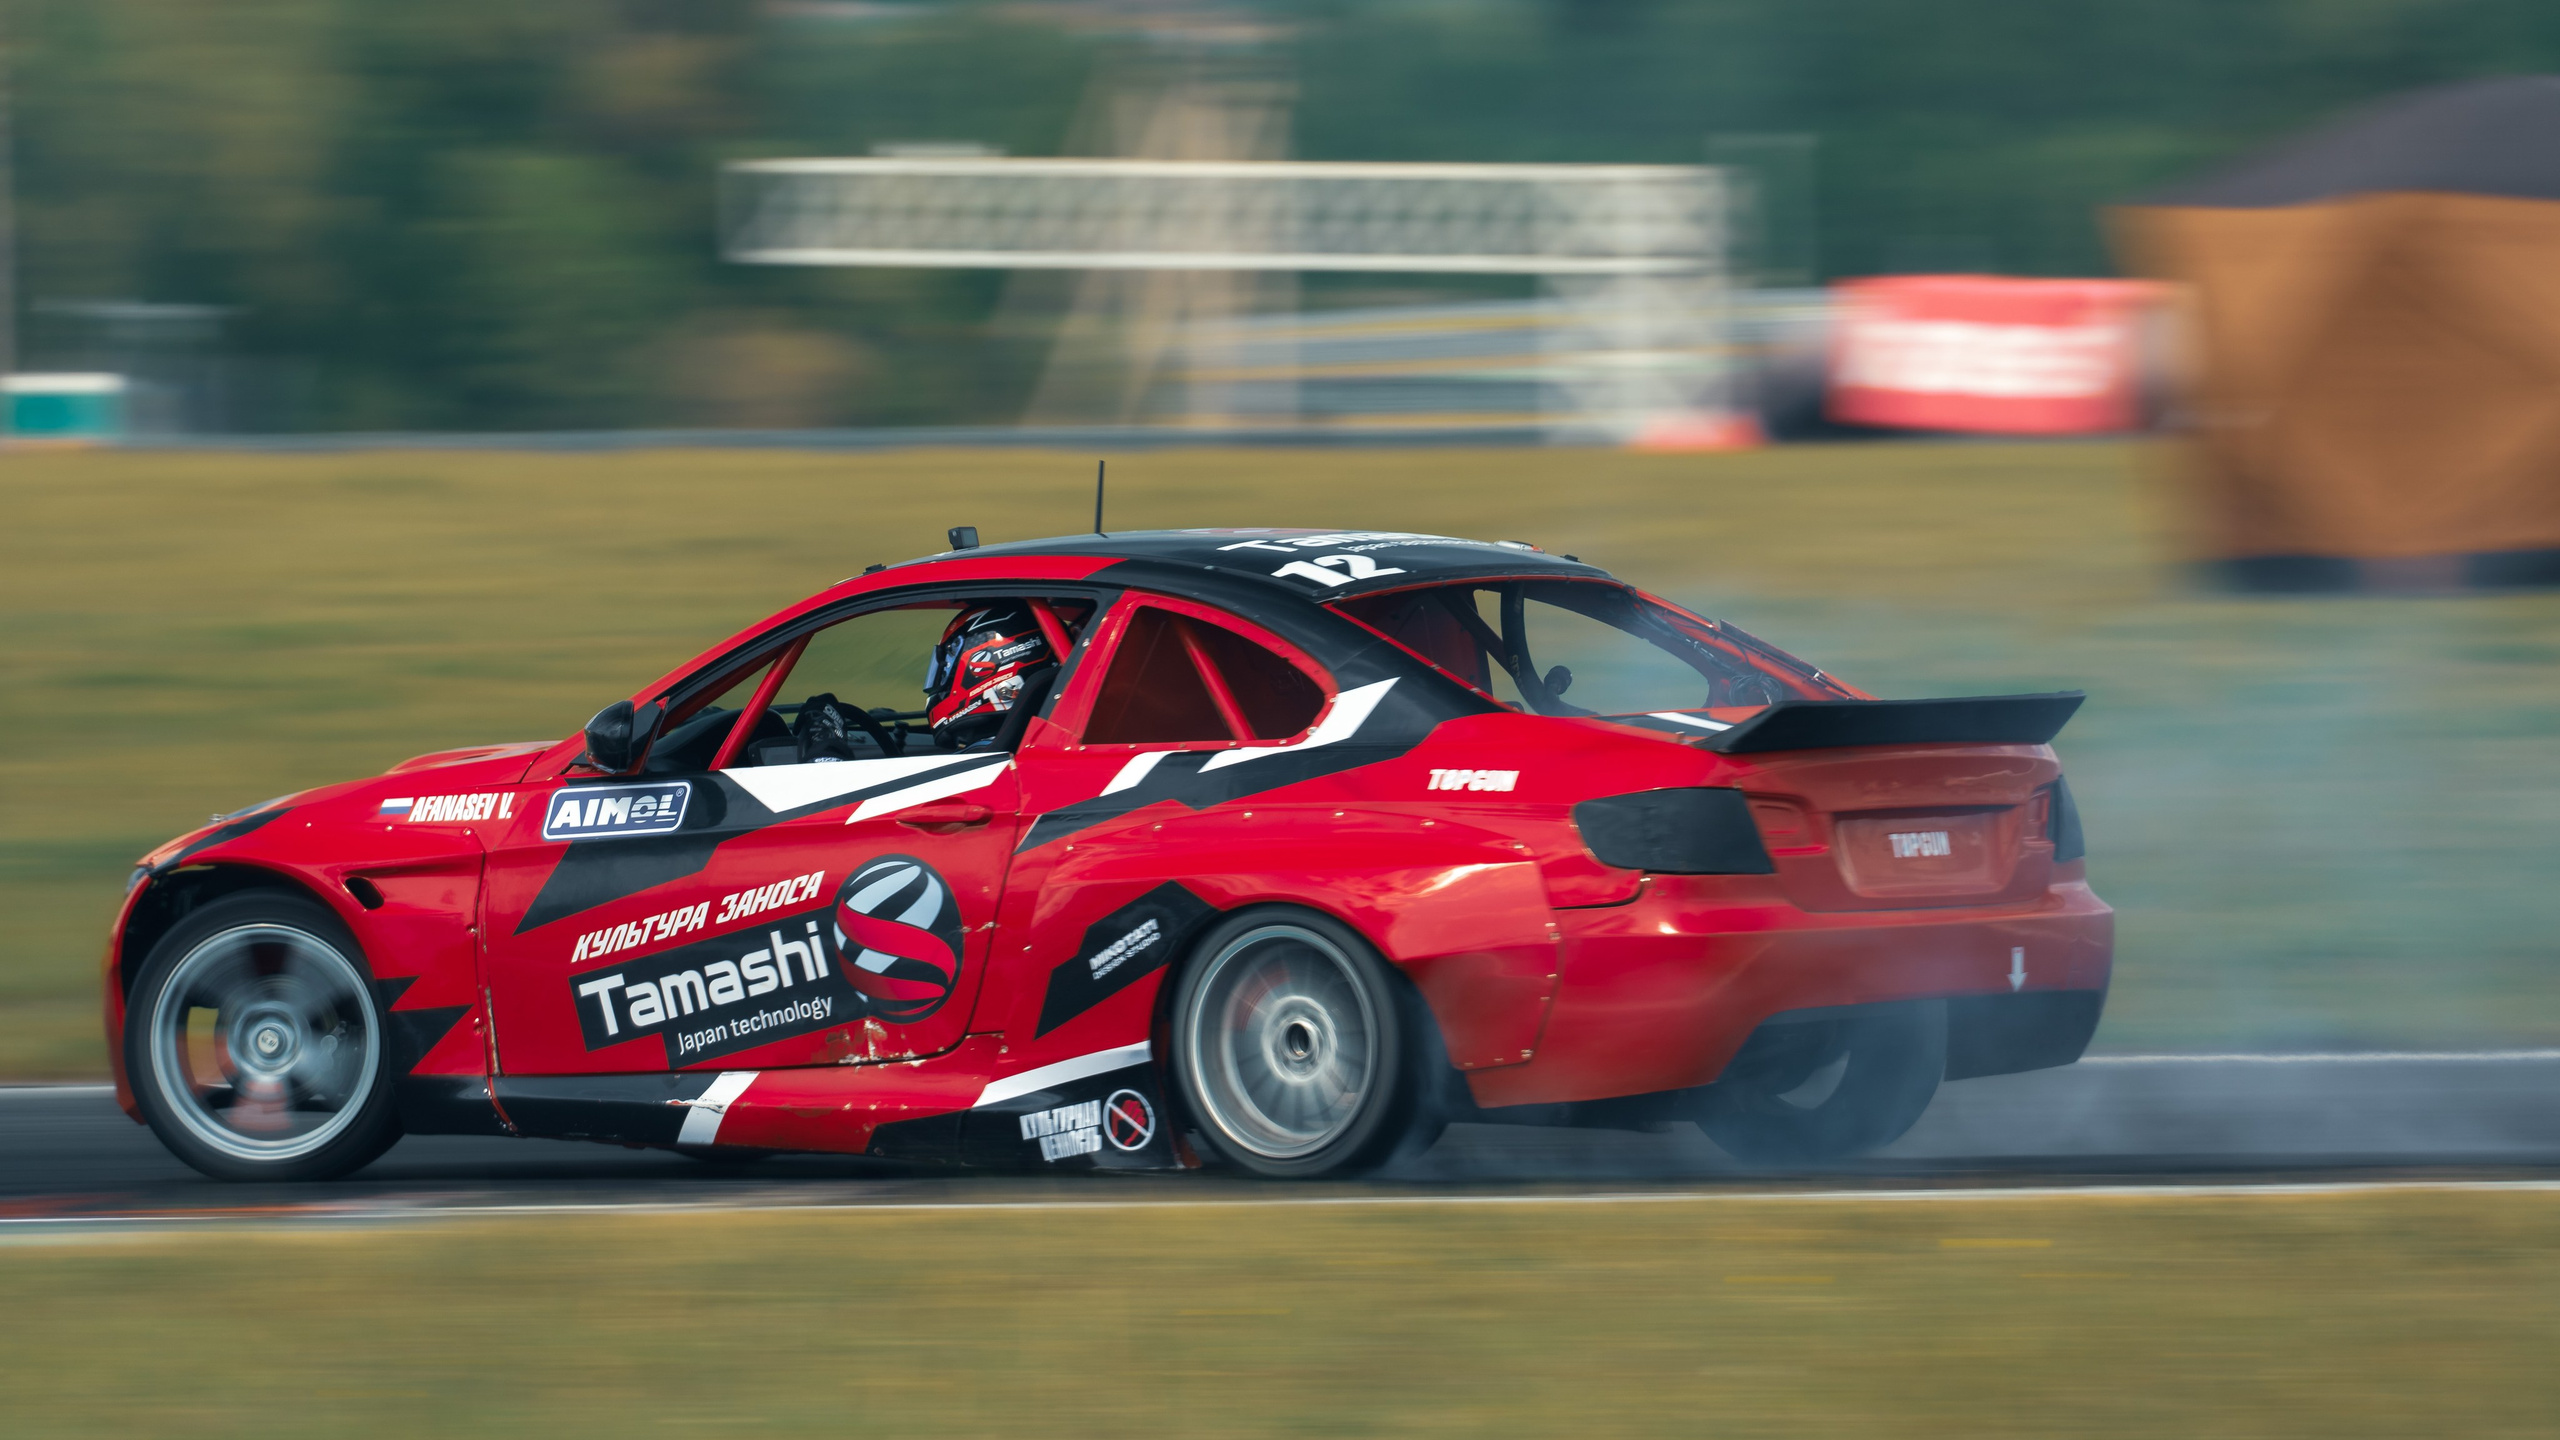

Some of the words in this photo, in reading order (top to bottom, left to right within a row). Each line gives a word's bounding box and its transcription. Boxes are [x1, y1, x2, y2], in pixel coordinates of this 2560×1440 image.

[1270, 554, 1407, 588] 12
[993, 636, 1043, 661] Tamashi
[1427, 768, 1520, 792] TOPGUN
[408, 793, 500, 822] AFANASEV
[498, 792, 515, 820] V.
[1888, 831, 1951, 858] TOPGUN
[570, 900, 711, 963] КУЛЬТУРА
[716, 870, 826, 924] ЗАНОСА
[578, 920, 830, 1037] Tamashi
[678, 1027, 728, 1055] Japan
[730, 996, 833, 1033] technology
